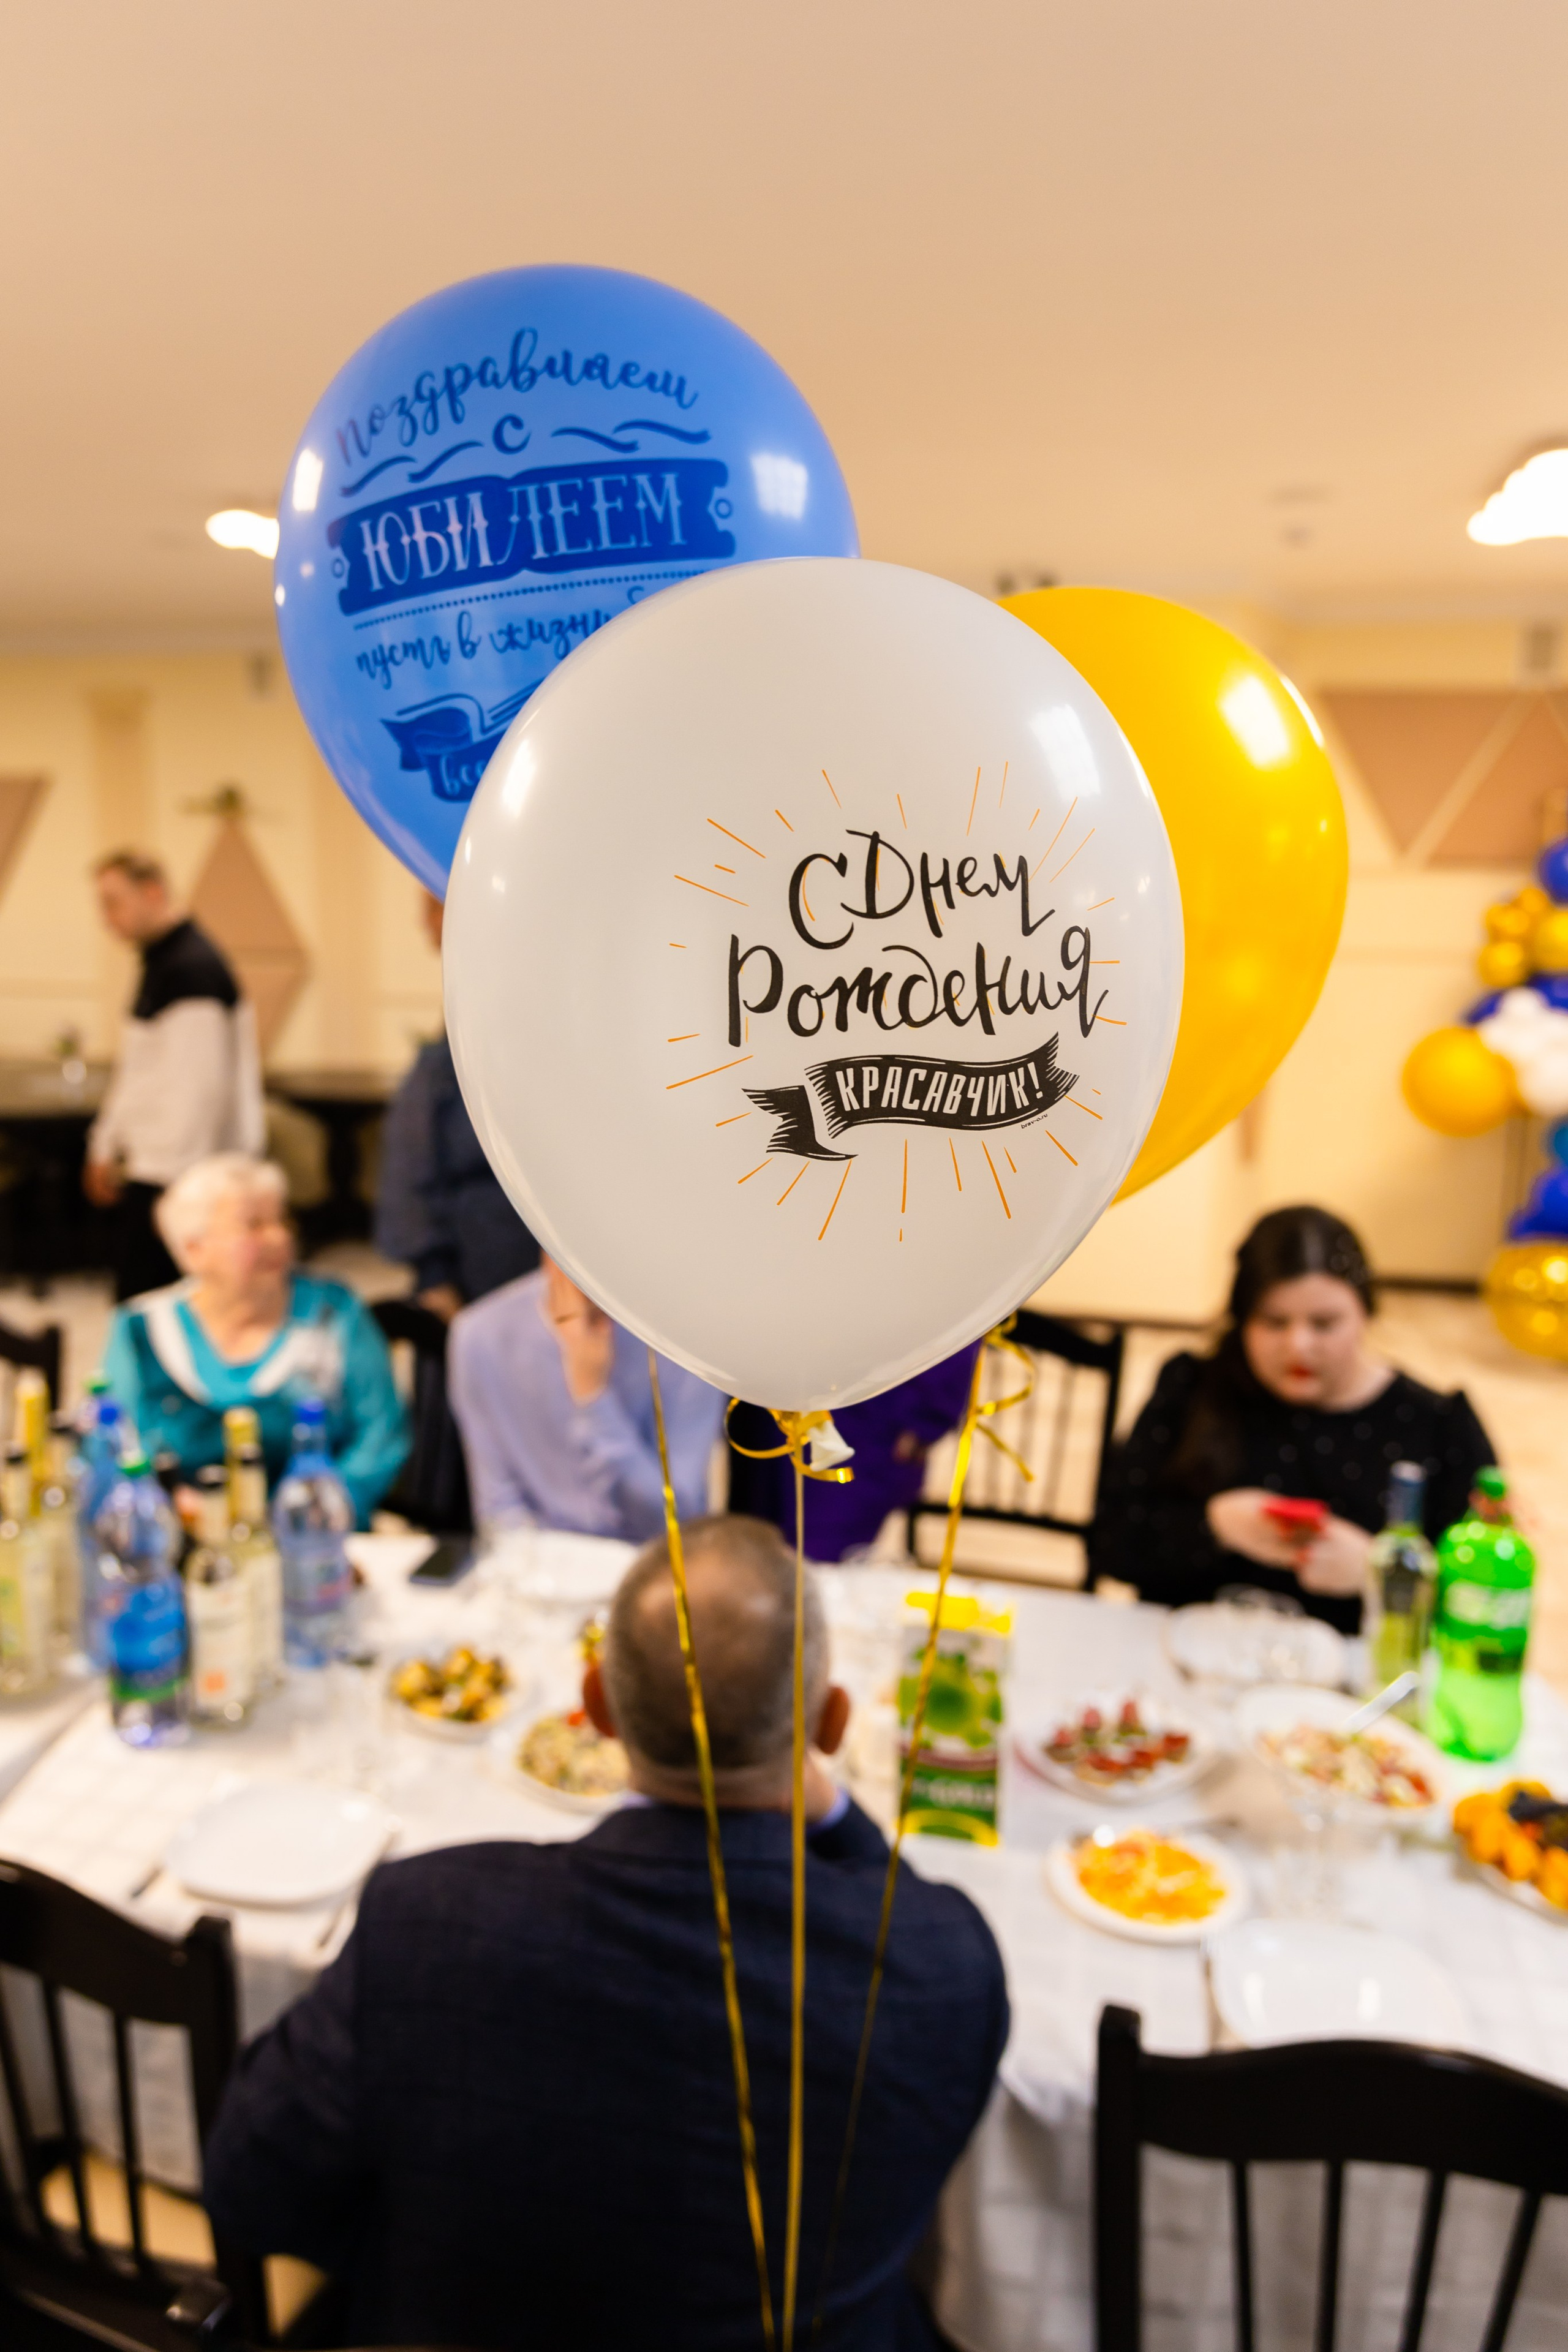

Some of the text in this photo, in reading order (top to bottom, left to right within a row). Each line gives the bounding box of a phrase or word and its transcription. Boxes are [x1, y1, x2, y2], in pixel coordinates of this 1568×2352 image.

[359, 471, 687, 592] ЮБИЛЕЕМ
[728, 925, 1109, 1048] Рождения
[835, 1061, 1044, 1117] КРАСАВЧИК!
